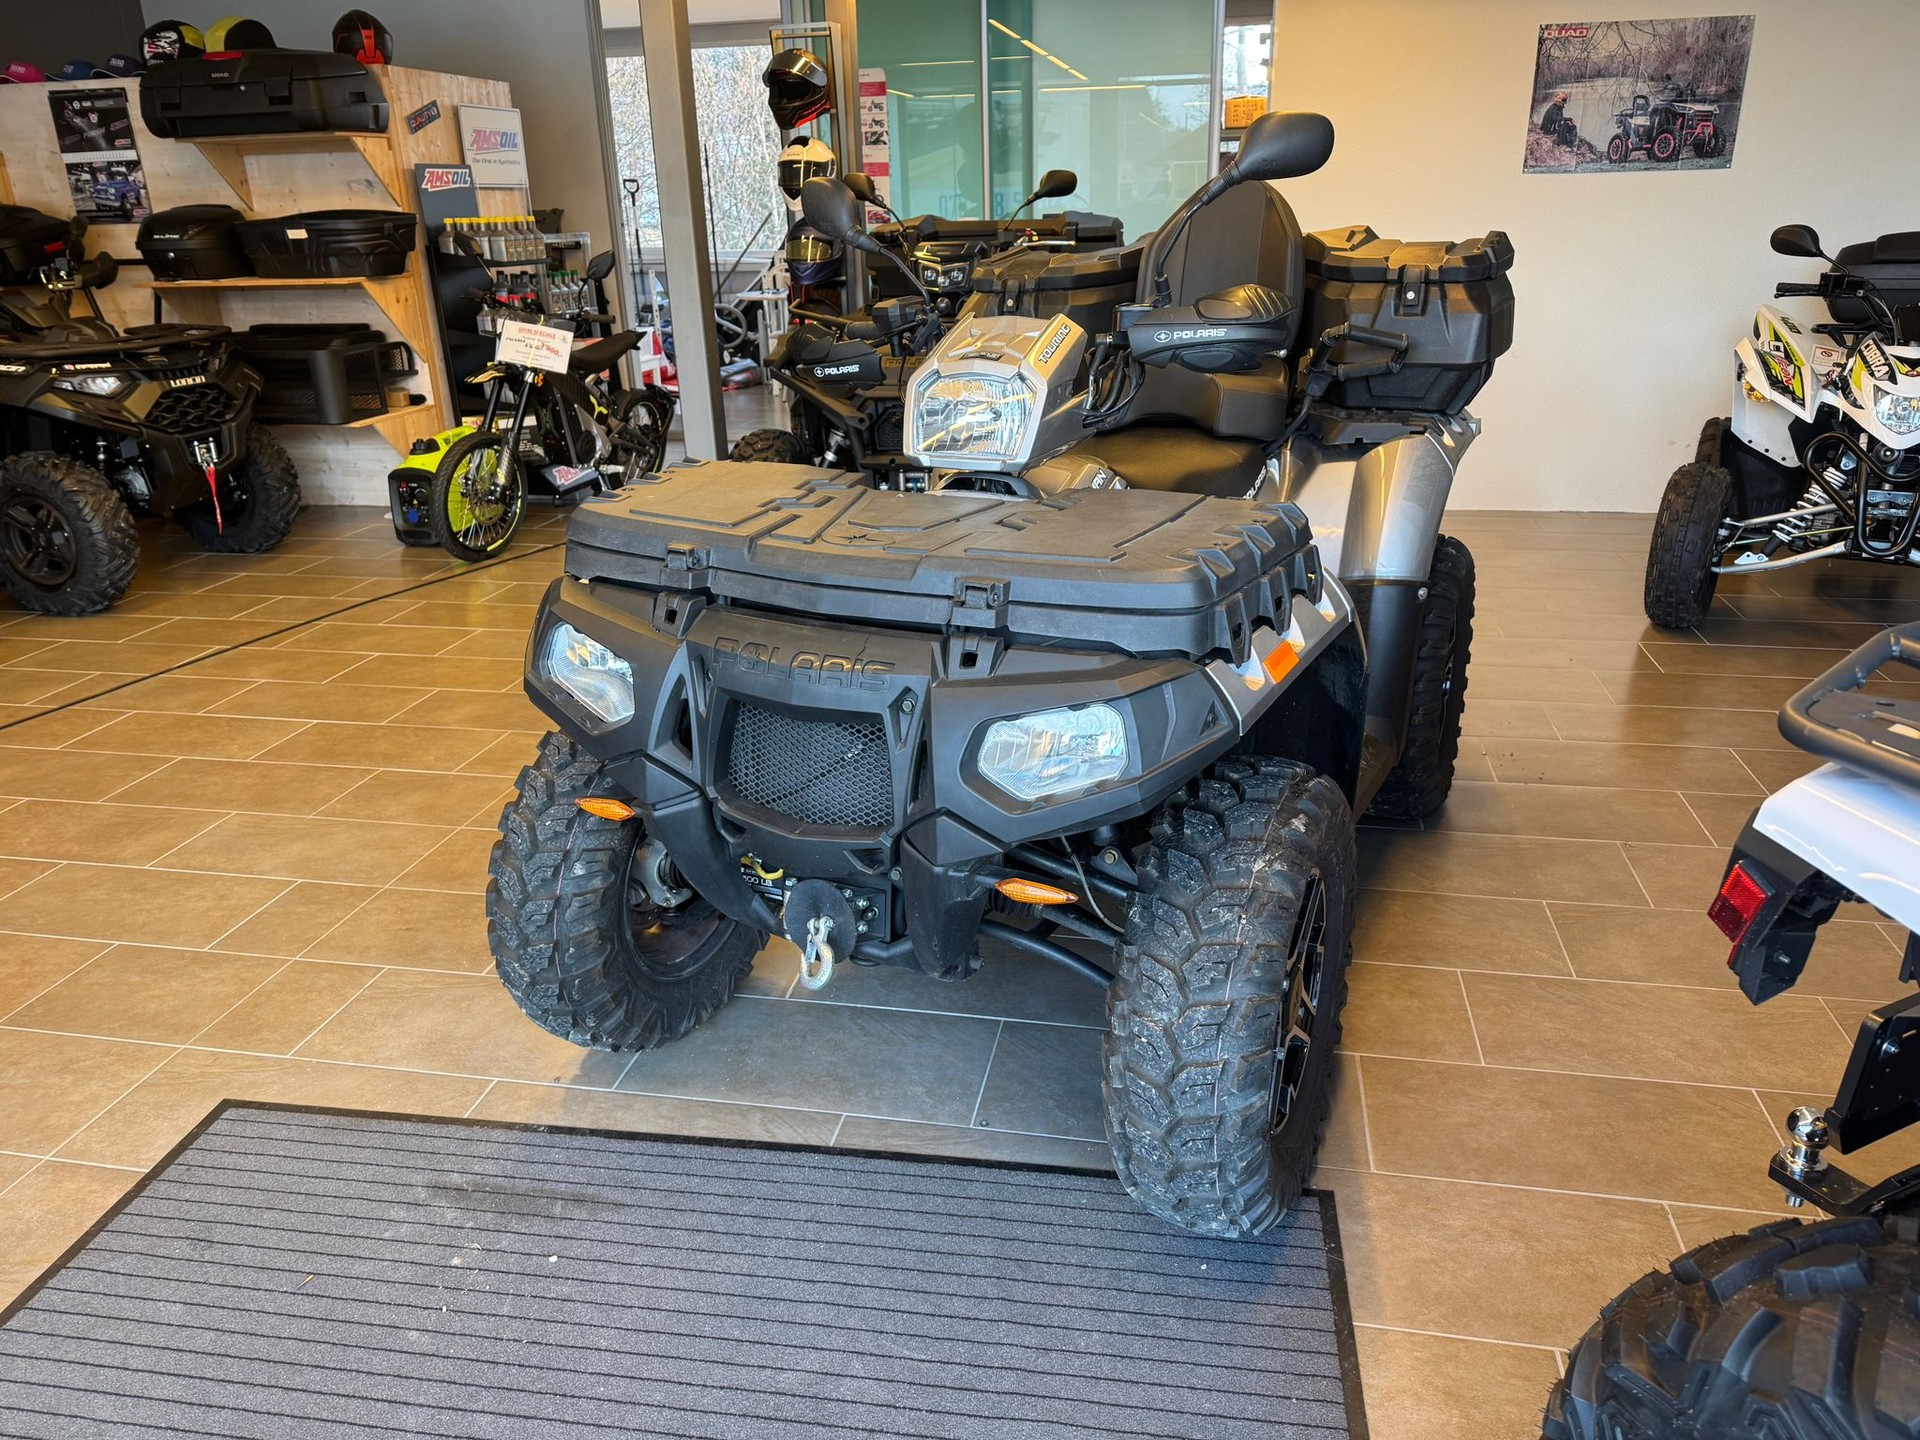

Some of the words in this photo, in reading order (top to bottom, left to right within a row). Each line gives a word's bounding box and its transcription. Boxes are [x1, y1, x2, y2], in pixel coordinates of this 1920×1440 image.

[1545, 28, 1588, 38] QUAD
[470, 129, 519, 151] AMSOIL
[422, 169, 470, 190] AMSOIL
[1038, 323, 1071, 364] TOURING
[1173, 328, 1227, 341] POLARIS
[1860, 339, 1889, 378] COBRA
[824, 364, 860, 376] POLARIS
[1243, 465, 1266, 499] OLARIS
[711, 636, 896, 692] POLARIS
